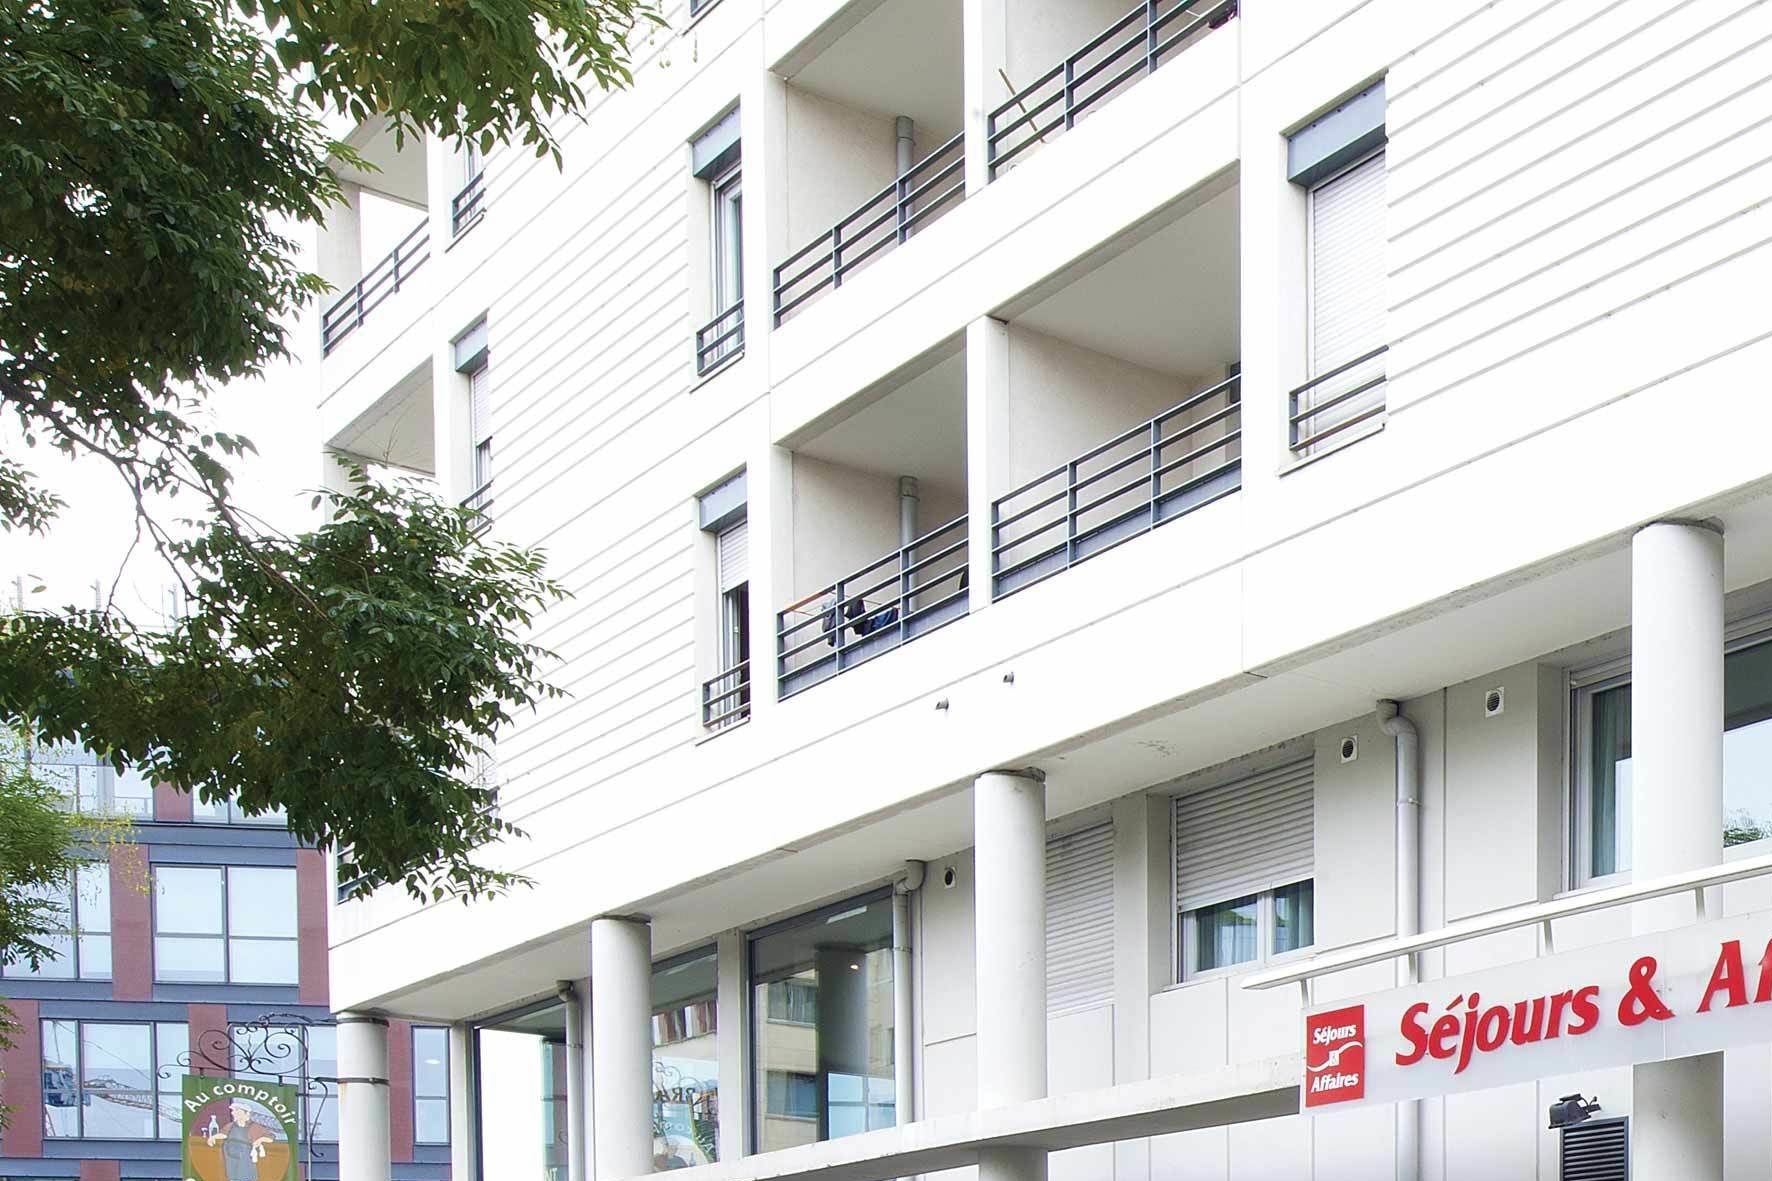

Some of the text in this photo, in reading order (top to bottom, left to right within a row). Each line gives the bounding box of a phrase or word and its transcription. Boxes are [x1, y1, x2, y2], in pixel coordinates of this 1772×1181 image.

[1395, 986, 1600, 1074] Séjours
[1617, 956, 1675, 1027] &
[1312, 1024, 1357, 1046] Séjours
[1310, 1072, 1359, 1093] Affaires
[184, 1083, 297, 1126] Au comptoir
